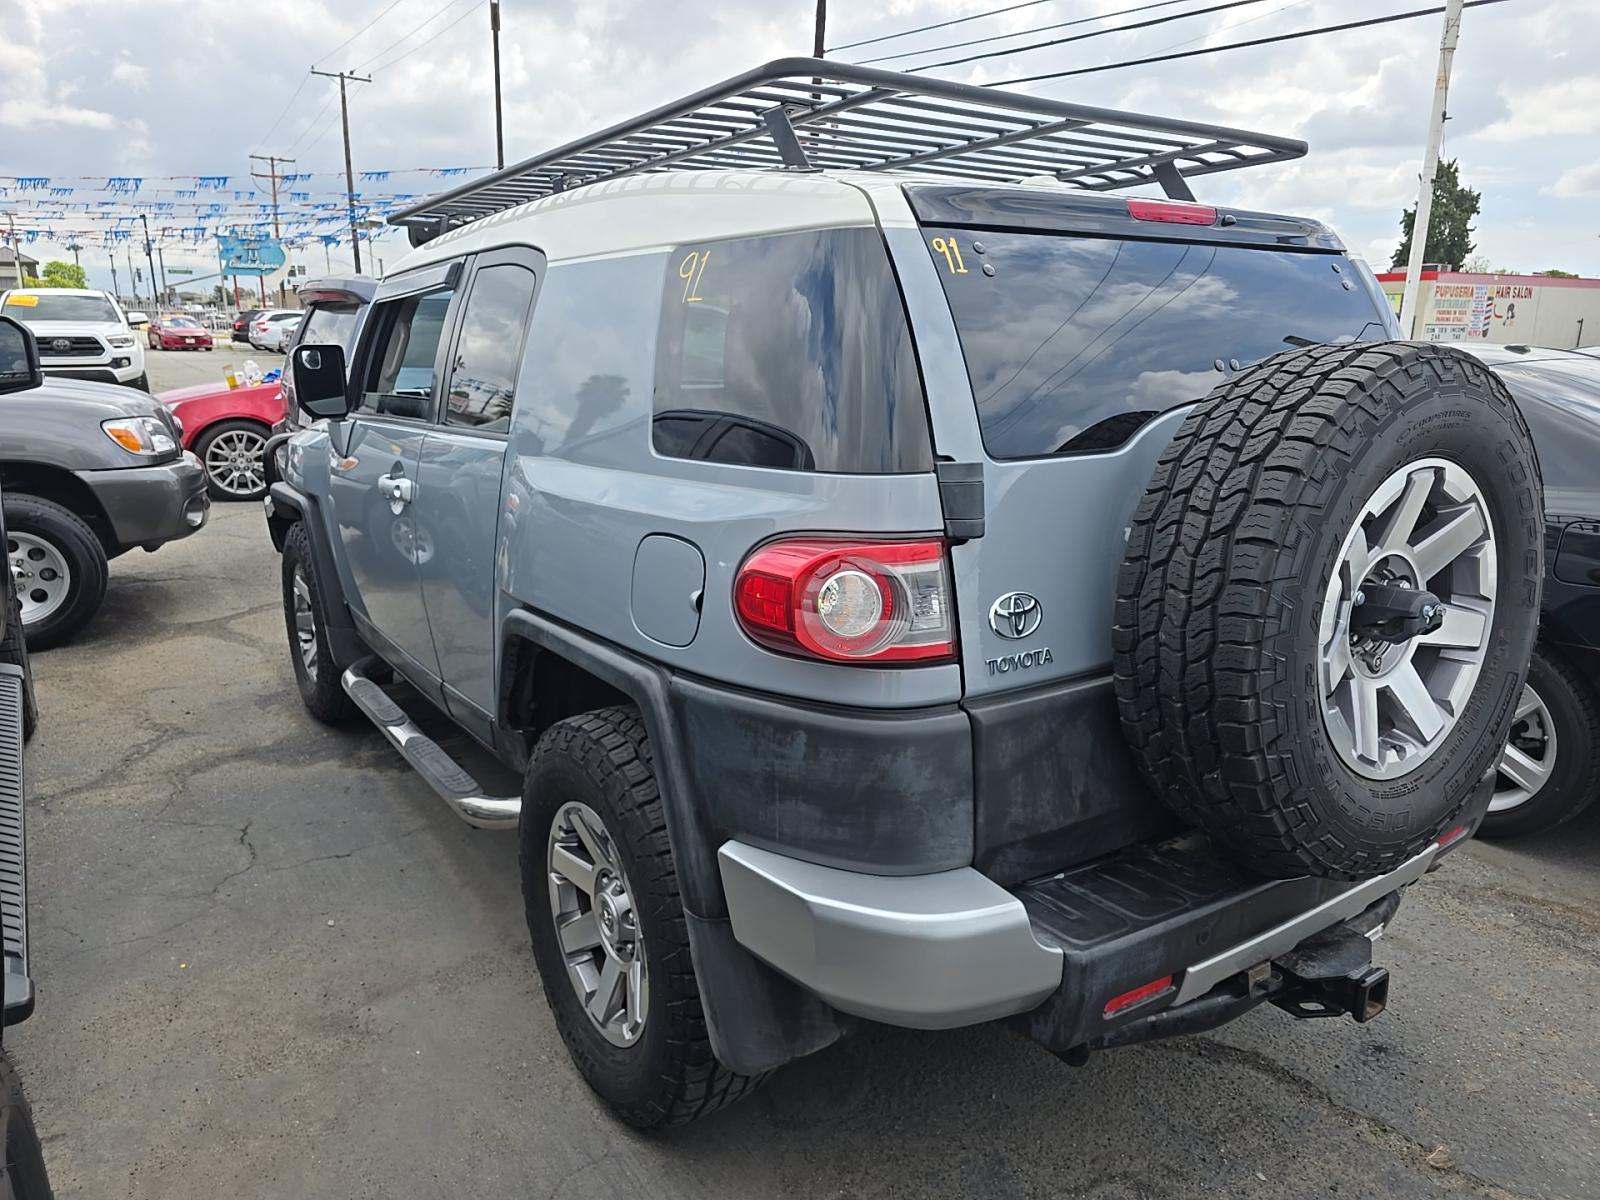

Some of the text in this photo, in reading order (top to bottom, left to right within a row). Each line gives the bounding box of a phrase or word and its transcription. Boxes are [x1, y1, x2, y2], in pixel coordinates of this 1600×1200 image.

[932, 237, 968, 274] 91
[679, 250, 711, 304] 91
[1434, 285, 1474, 298] PUPUSERIA
[1495, 286, 1511, 299] HAIR
[1512, 286, 1533, 299] SALON
[985, 648, 1054, 676] TOYOTA
